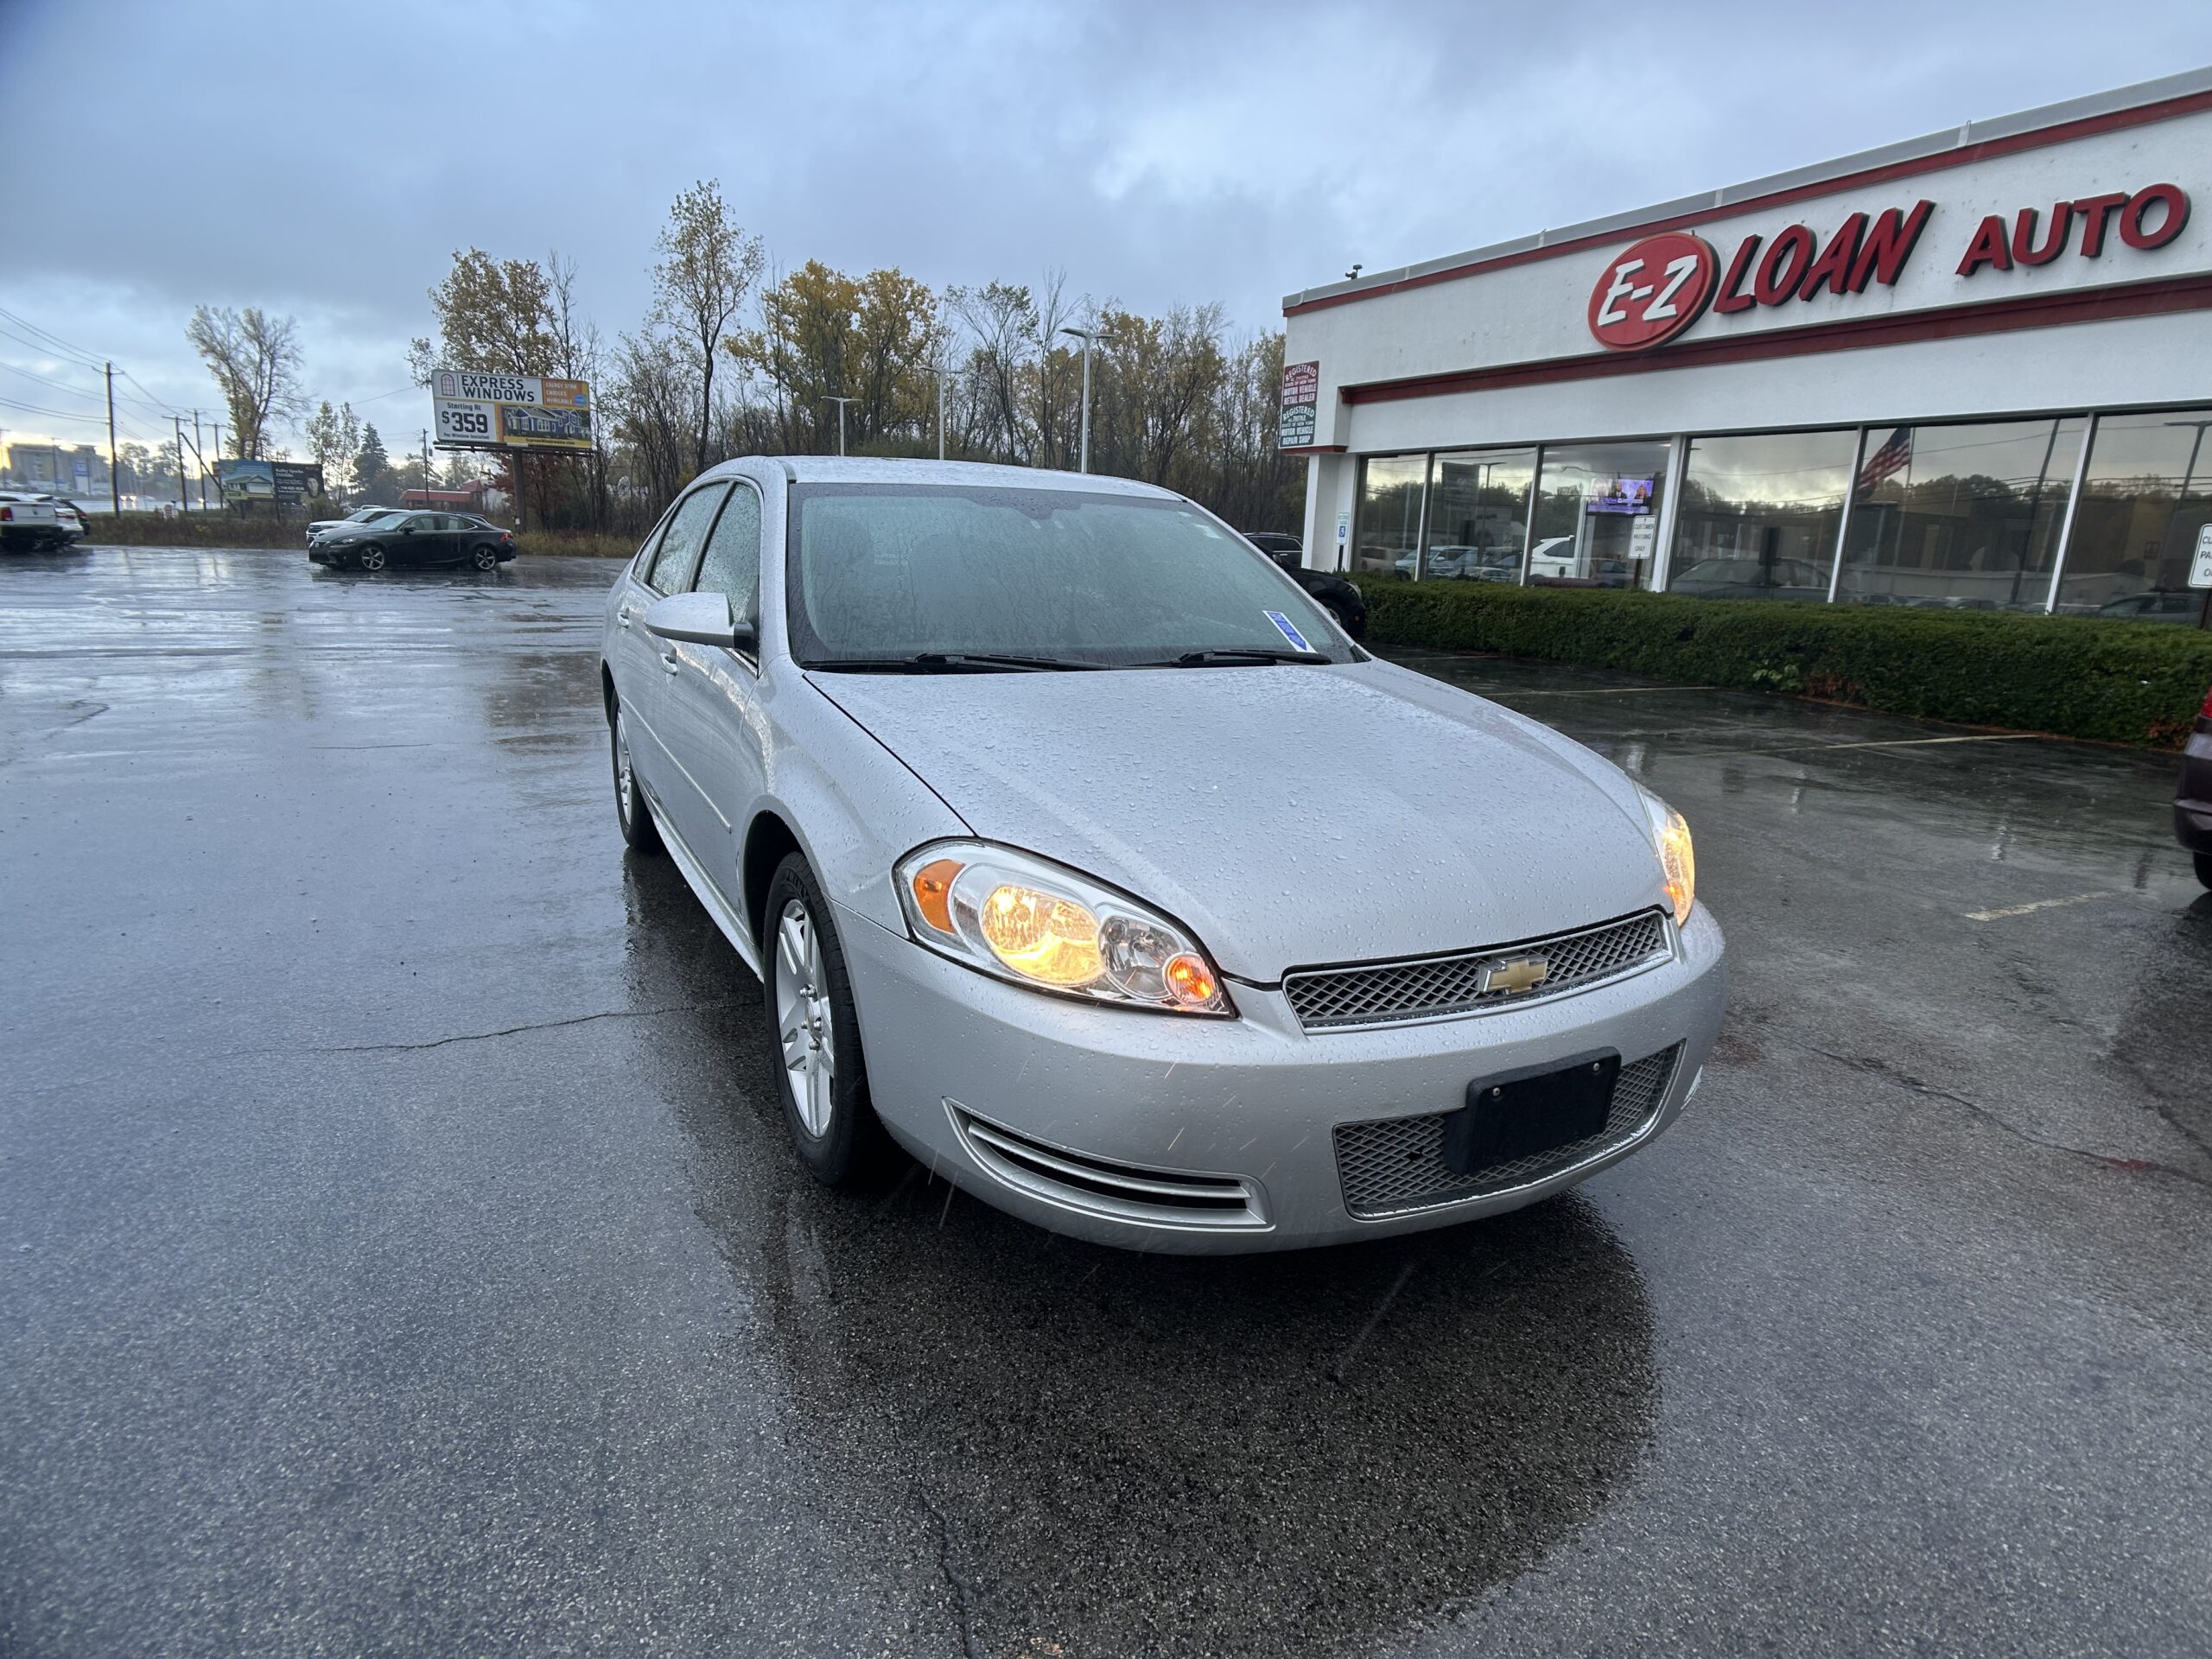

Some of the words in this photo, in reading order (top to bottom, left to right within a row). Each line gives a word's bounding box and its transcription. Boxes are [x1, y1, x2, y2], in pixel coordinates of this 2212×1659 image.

[1598, 253, 1698, 327] E-Z
[1713, 200, 1937, 314] LOAN
[1955, 182, 2191, 277] AUTO
[1285, 364, 1317, 382] REGISTERED
[461, 375, 524, 390] EXPRESS
[463, 387, 535, 402] WINDOWS
[1284, 387, 1299, 397] MOTOR
[1299, 384, 1317, 394] VEHICLE
[1284, 395, 1298, 405] RETAIL
[1299, 392, 1315, 403] DEALER
[447, 402, 474, 411] Starting
[1282, 405, 1315, 421] REGISTERED
[442, 410, 488, 433] $359
[1281, 428, 1295, 436] MOTOR
[1296, 425, 1313, 435] VEHICLE
[1282, 436, 1298, 445] REPAIR
[1299, 435, 1311, 444] SHOP
